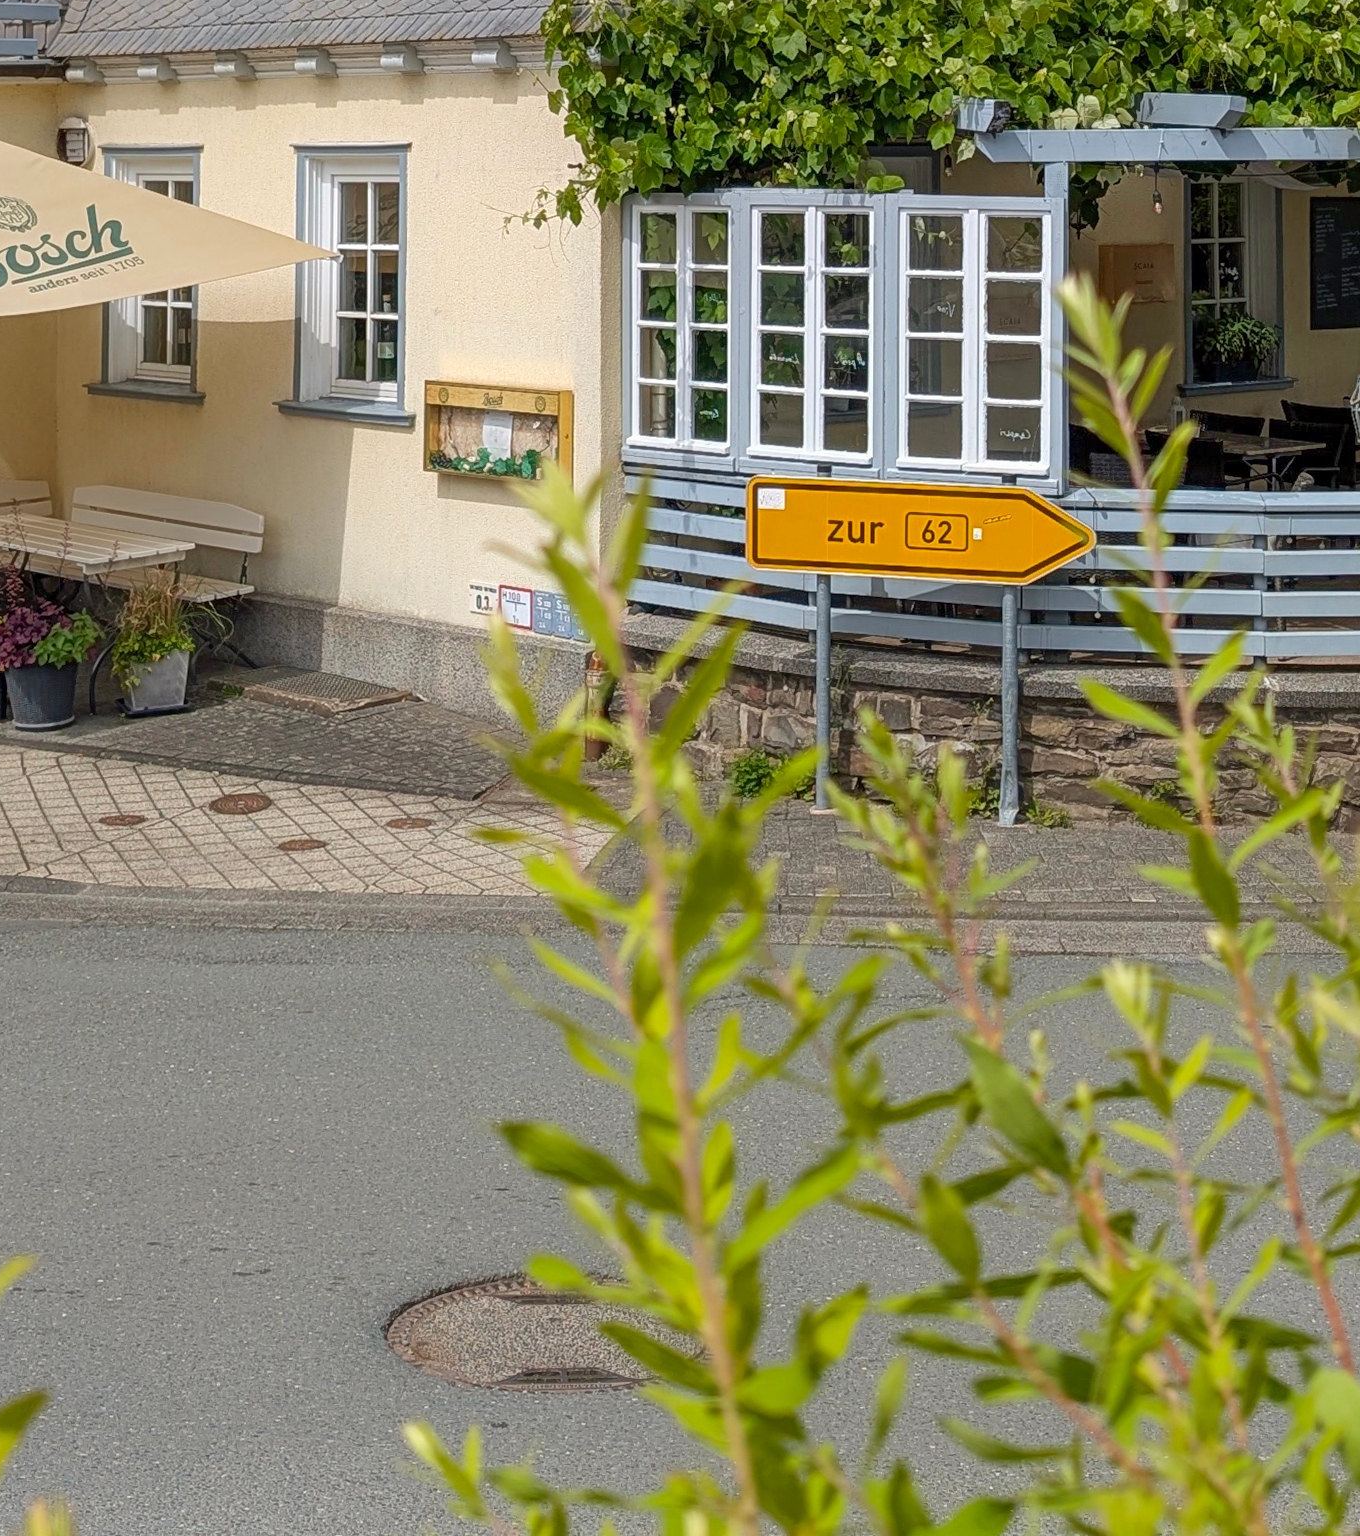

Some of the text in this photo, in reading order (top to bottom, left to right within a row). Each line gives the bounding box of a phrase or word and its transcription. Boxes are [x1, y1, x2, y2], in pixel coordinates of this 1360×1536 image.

[28, 256, 146, 294] anders seit 1705
[827, 519, 952, 544] zur 62
